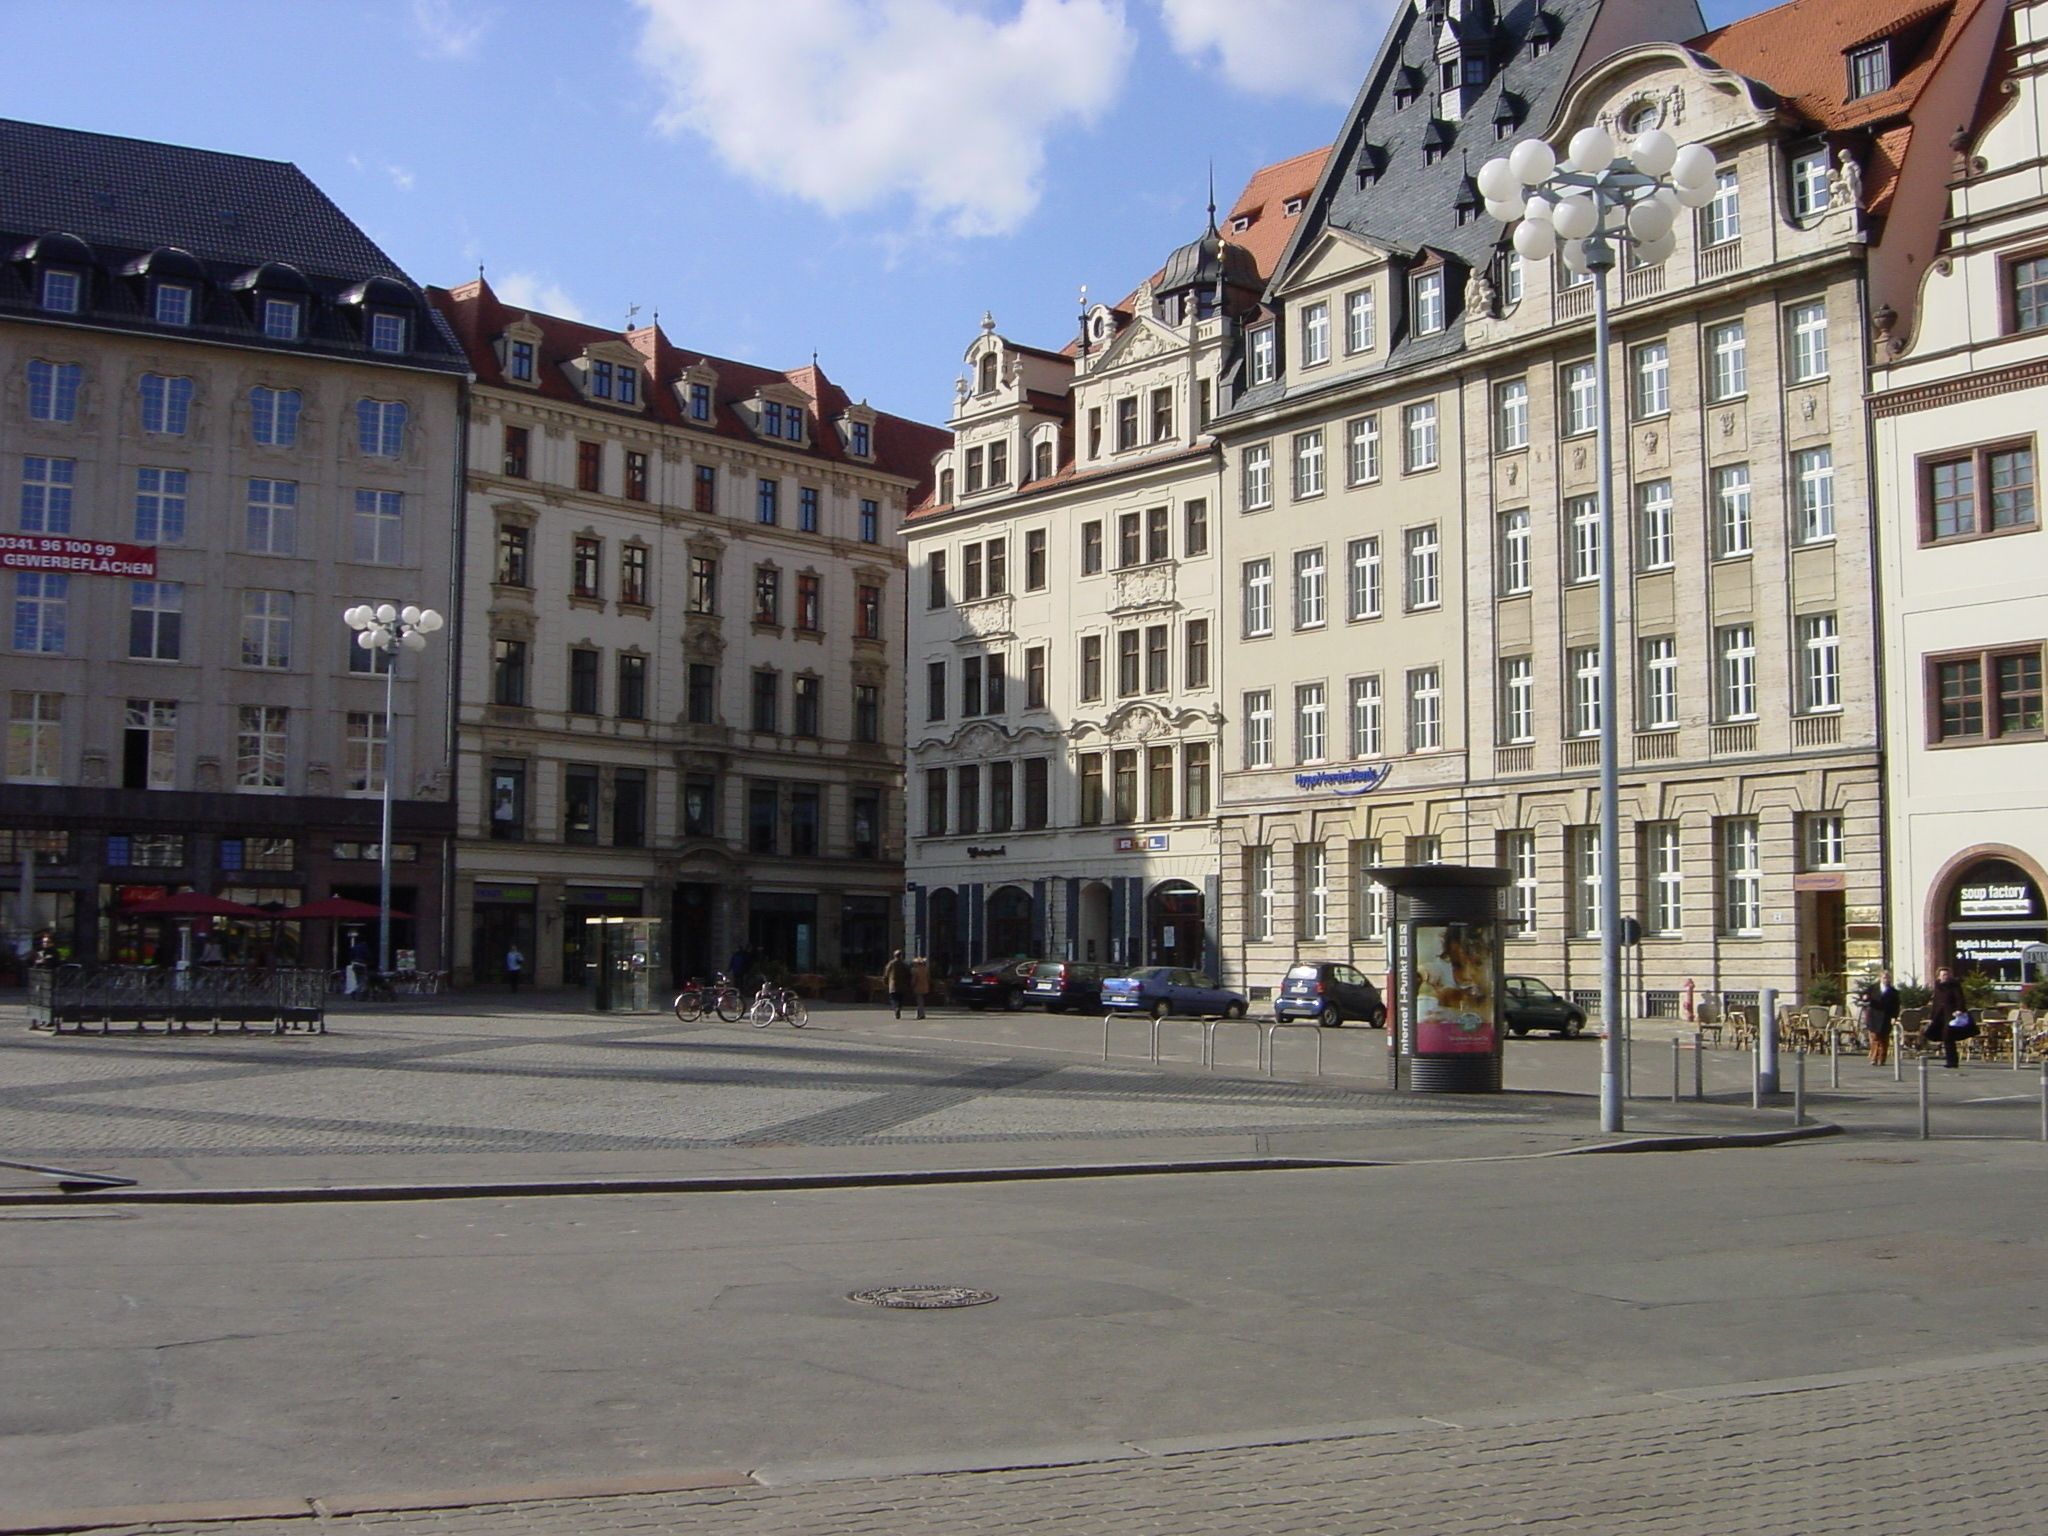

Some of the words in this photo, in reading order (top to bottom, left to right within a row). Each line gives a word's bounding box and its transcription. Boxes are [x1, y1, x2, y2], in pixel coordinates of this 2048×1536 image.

[41, 539, 61, 552] 96
[65, 541, 91, 554] 100
[95, 544, 116, 557] 99
[4, 554, 153, 575] GEWERBEFLÄCHEN
[1119, 837, 1163, 850] RTL
[1961, 888, 1987, 900] soup
[1988, 885, 2026, 900] factory
[1401, 1006, 1409, 1055] Internet
